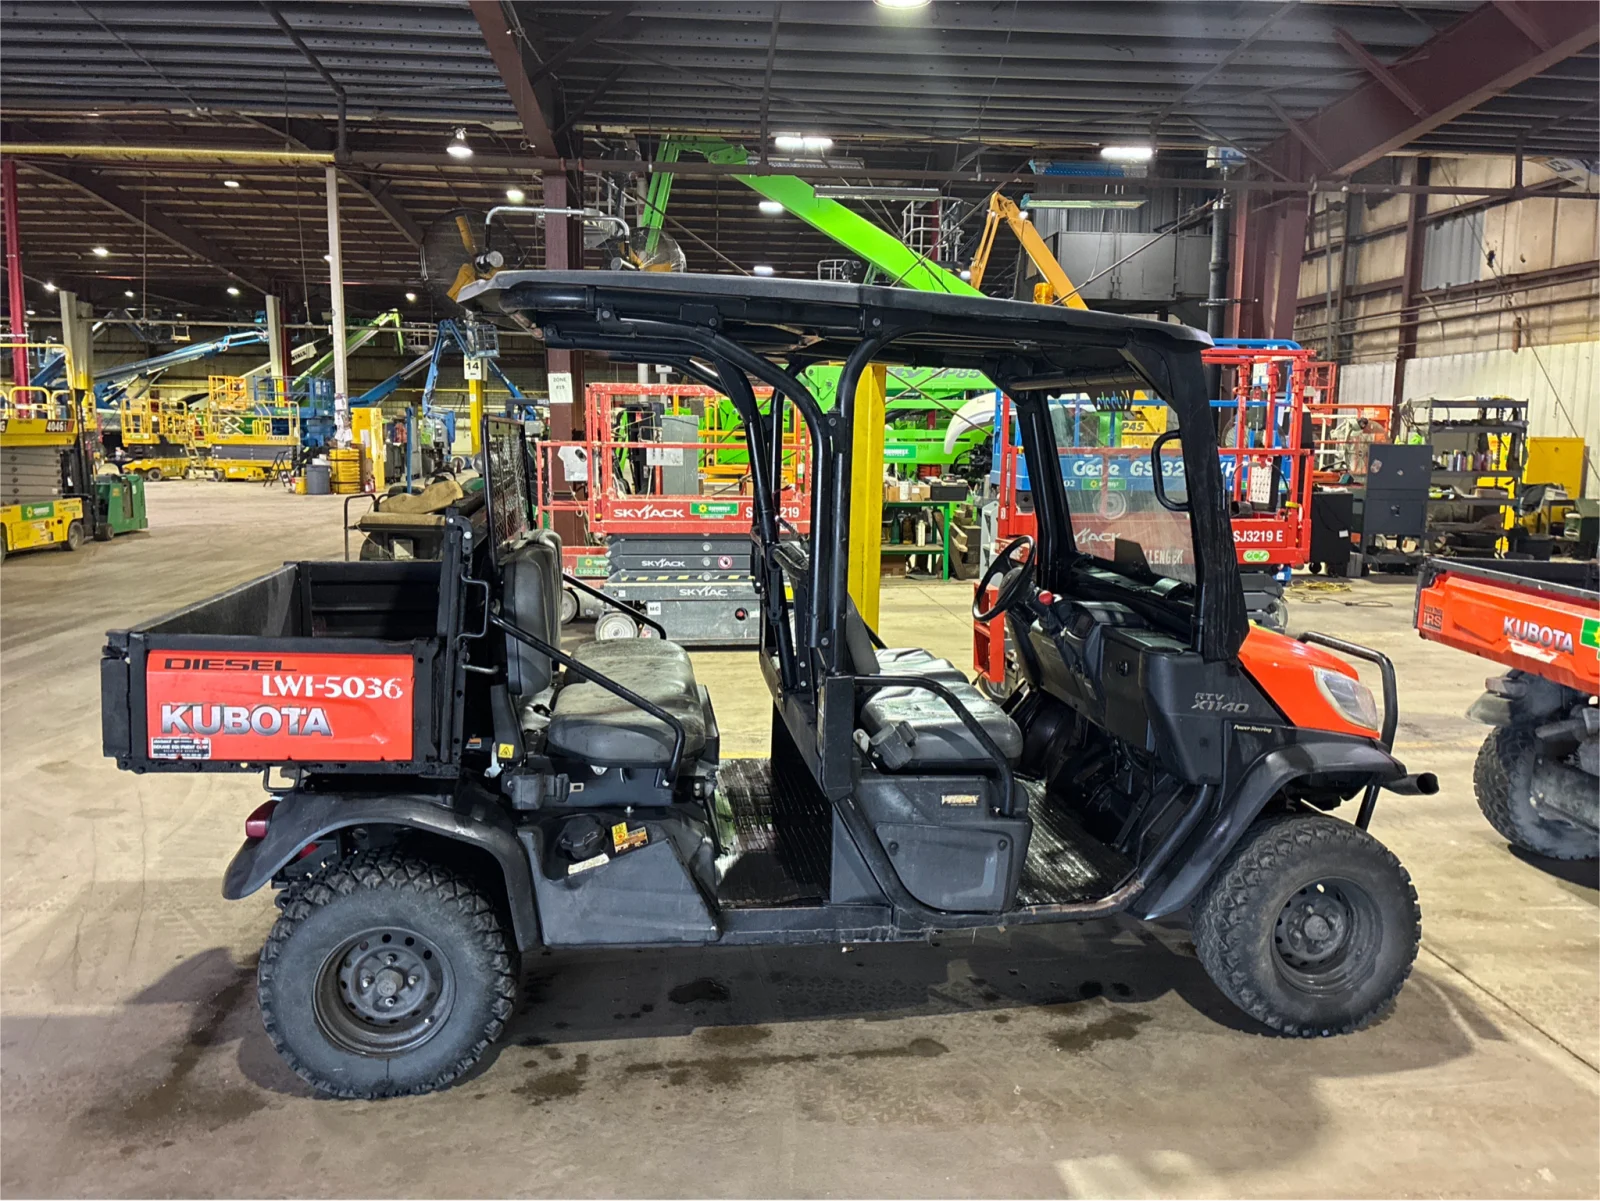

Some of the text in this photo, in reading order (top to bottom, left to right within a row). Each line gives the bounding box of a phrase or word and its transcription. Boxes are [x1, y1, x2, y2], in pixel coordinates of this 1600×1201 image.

[466, 362, 480, 371] 14
[1072, 458, 1120, 477] Gene
[613, 504, 685, 519] SKYJACK
[1074, 528, 1122, 544] YJACK
[1233, 530, 1284, 542] SJ3219 E
[641, 558, 686, 568] SKYJACK
[679, 585, 728, 597] SKYJAC
[1503, 616, 1575, 655] KUBOTA
[164, 658, 297, 672] DIESEL
[262, 674, 403, 700] LWI-5036
[1194, 692, 1225, 700] RTV
[1191, 700, 1250, 713] X1140
[160, 703, 334, 736] KUBOTA
[1250, 725, 1273, 733] Steering
